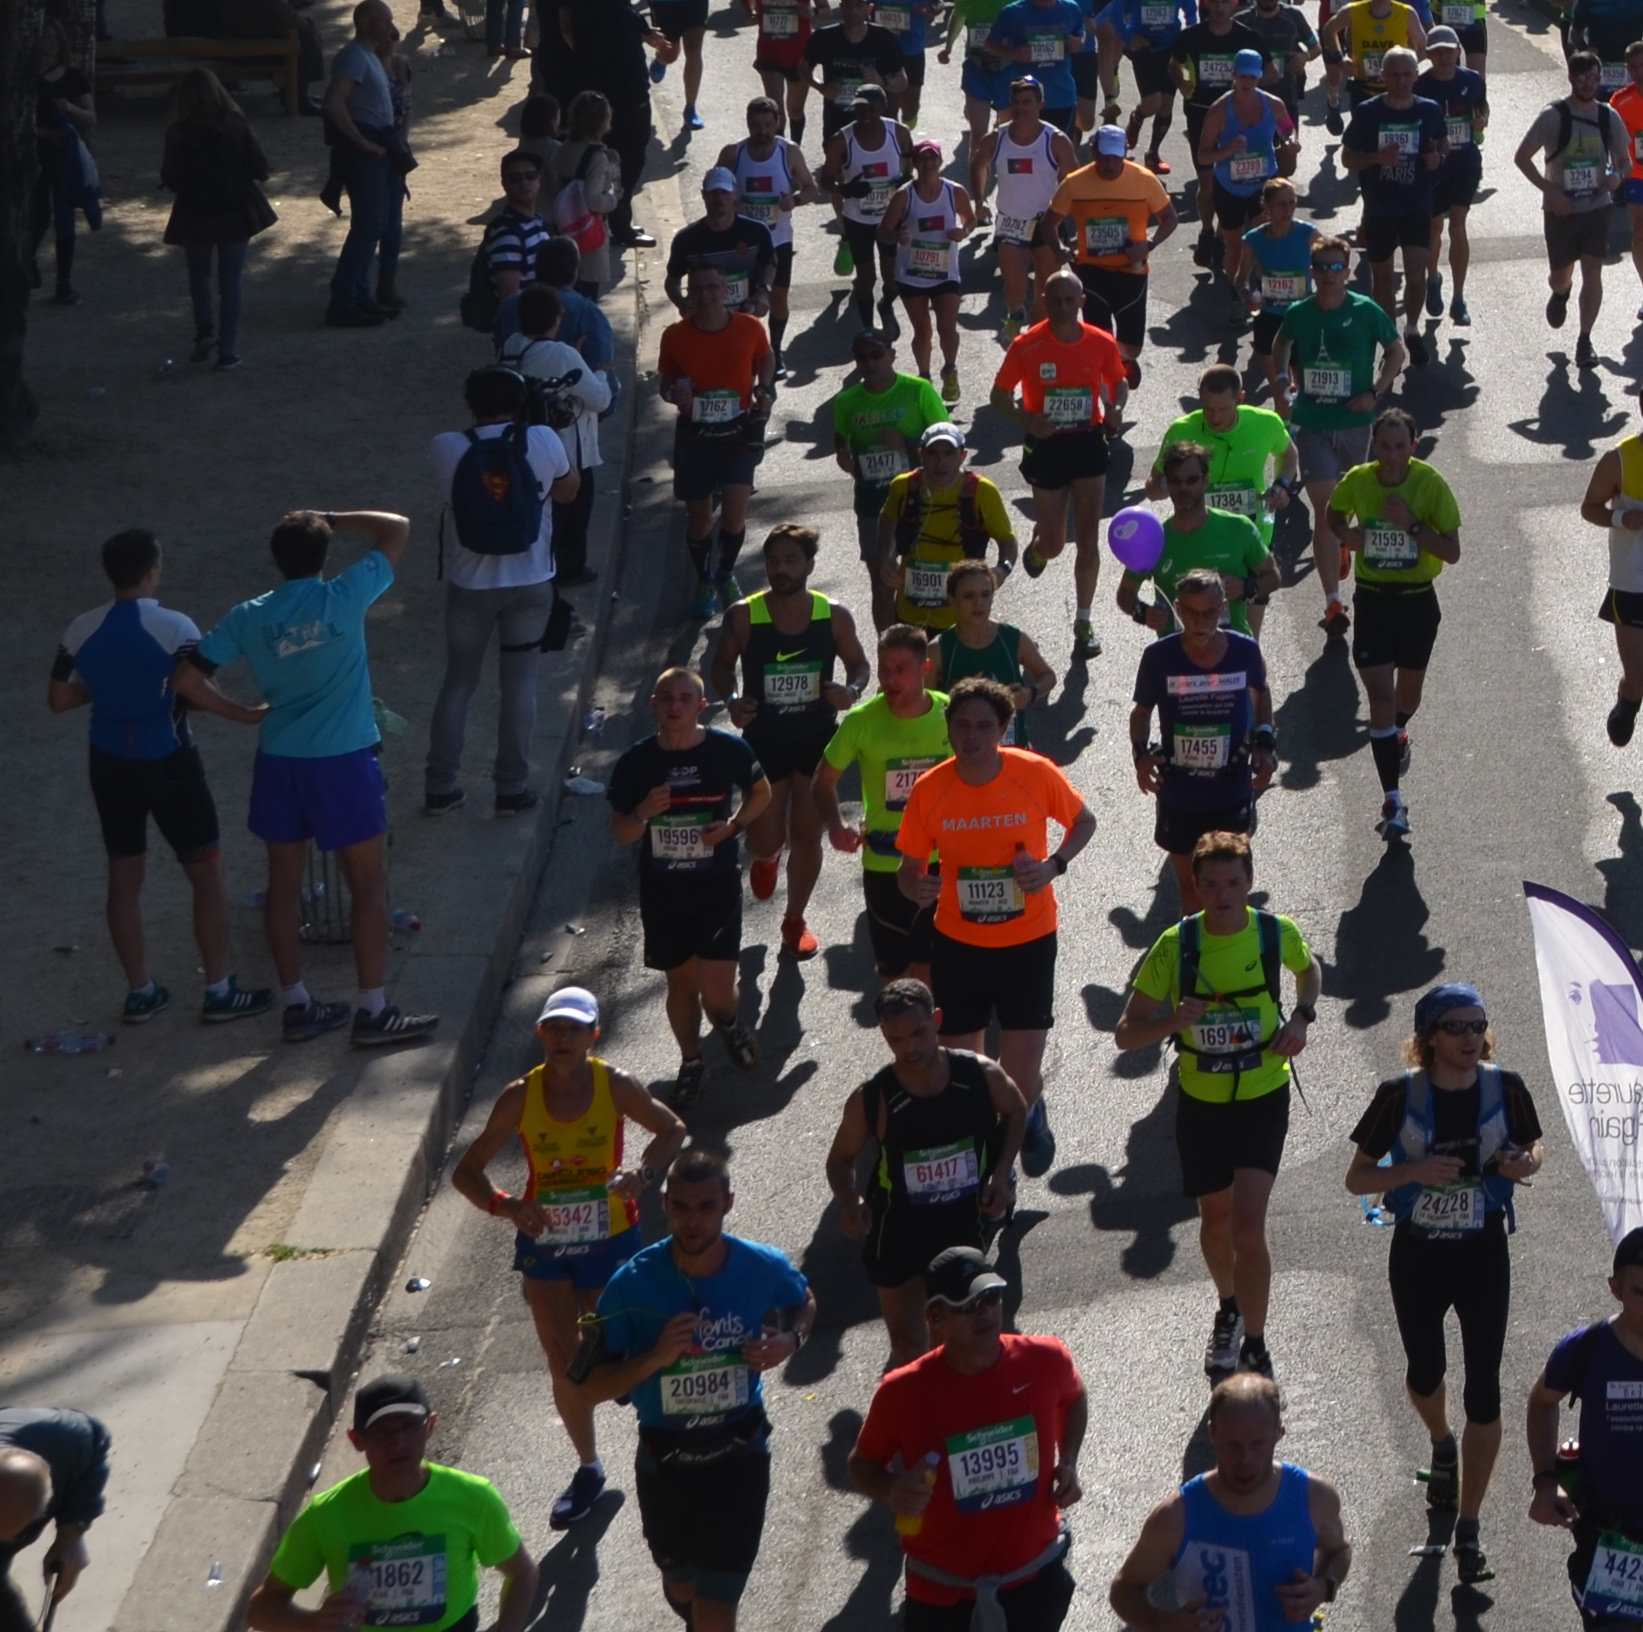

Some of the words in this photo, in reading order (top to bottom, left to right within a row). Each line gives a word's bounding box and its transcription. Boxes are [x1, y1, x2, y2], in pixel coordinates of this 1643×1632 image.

[1379, 166, 1417, 183] PARIS
[1091, 227, 1120, 238] 23505
[914, 250, 940, 263] 10791
[1268, 279, 1294, 290] 12162
[1311, 370, 1339, 384] 21913
[1210, 493, 1243, 508] 17384
[1371, 531, 1405, 546] 21593
[771, 676, 809, 692] 12978
[1180, 738, 1218, 756] 17455
[896, 771, 923, 788] 217
[942, 812, 1028, 832] MAARTEN
[657, 827, 699, 847] 19596
[967, 880, 1006, 899] 11123
[1222, 1060, 1244, 1072] ass
[916, 1157, 959, 1184] 61417
[1421, 1191, 1469, 1215] 24228
[1439, 1230, 1463, 1240] asics
[679, 1355, 726, 1370] Schneider
[671, 1370, 730, 1398] 20984
[698, 1414, 726, 1425] asics
[966, 1425, 1014, 1445] Schneider
[960, 1442, 1020, 1478] 13995
[993, 1489, 1022, 1505] asics
[372, 1540, 425, 1558] Schneider
[365, 1559, 425, 1590] 1862
[391, 1610, 421, 1623] asics
